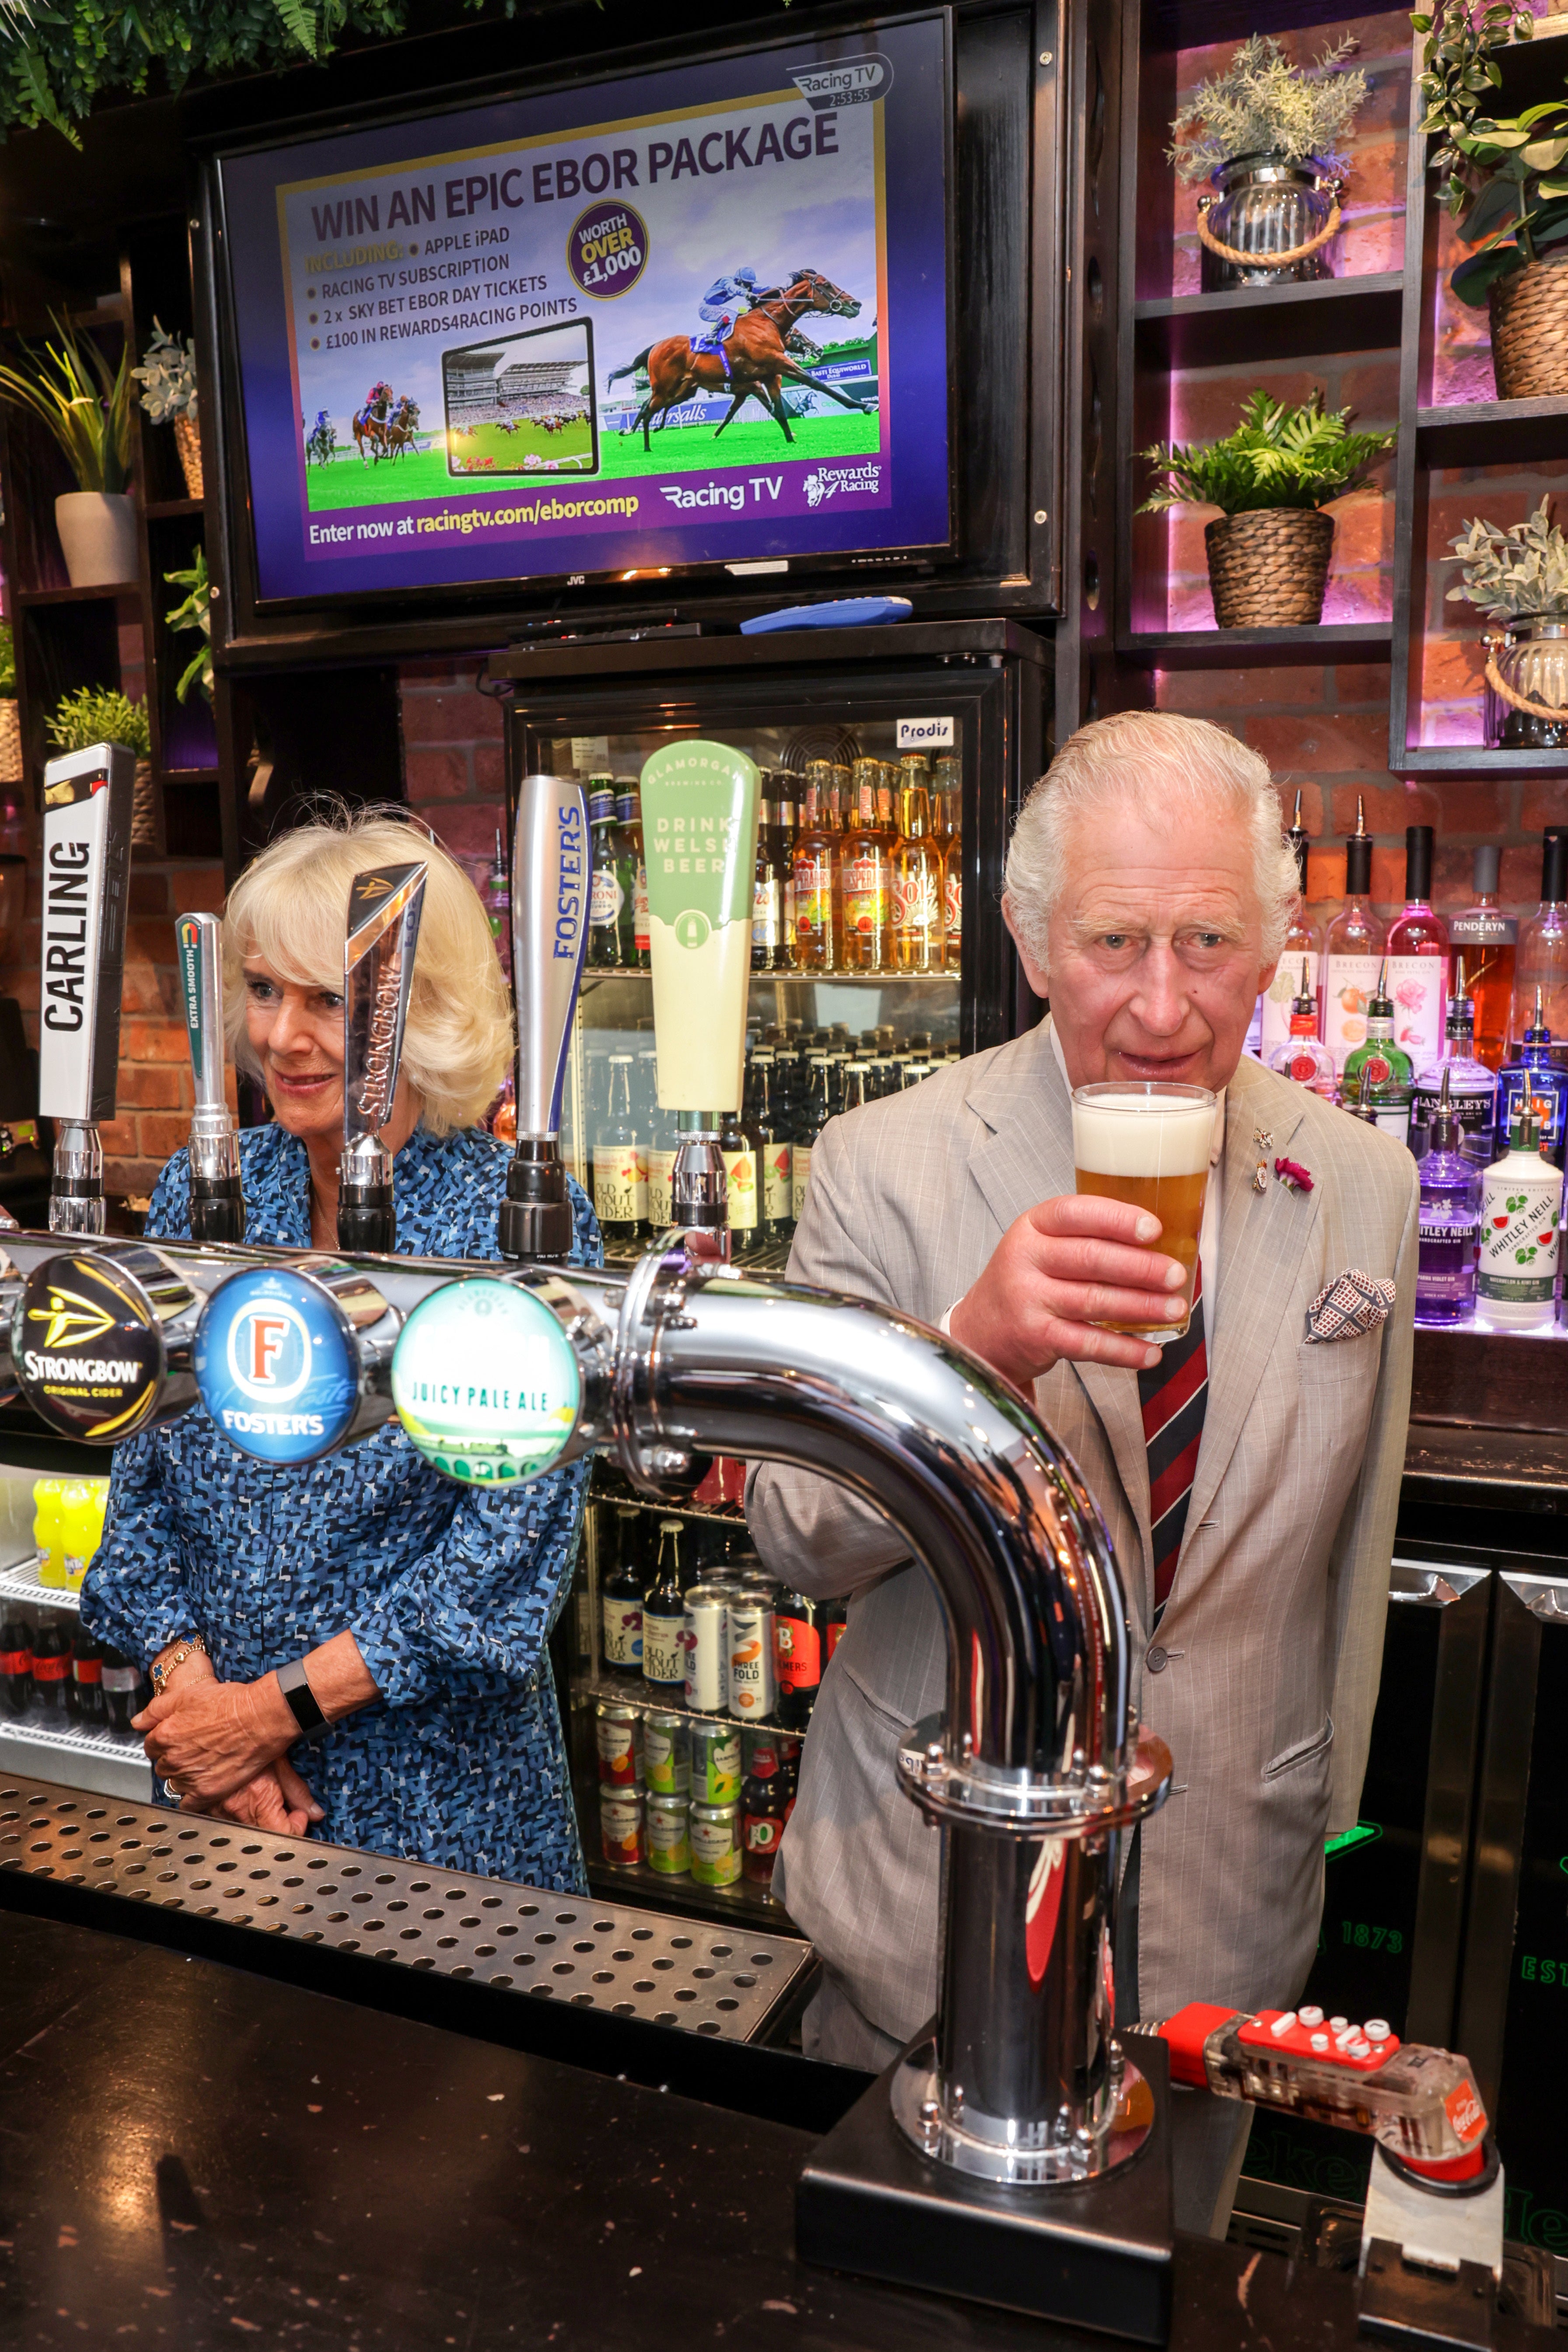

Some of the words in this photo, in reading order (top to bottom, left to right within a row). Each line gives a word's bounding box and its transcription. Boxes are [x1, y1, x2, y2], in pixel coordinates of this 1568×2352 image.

[797, 70, 852, 92] Racing
[854, 65, 875, 83] TV
[829, 89, 870, 107] 2:53:55
[311, 195, 380, 241] WIN
[387, 184, 436, 237] AN
[445, 168, 524, 219] EPIC
[533, 149, 639, 203] EBOR
[648, 112, 839, 184] PACKAGE
[578, 213, 628, 244] WORTH
[304, 239, 404, 276] INCLUDING:
[424, 229, 471, 256] APPLE
[475, 227, 510, 248] iPAD
[581, 227, 635, 264] OVER
[321, 271, 375, 299] RACING
[377, 273, 395, 291] TV
[398, 254, 510, 286] SUBSCRIPTION
[583, 246, 642, 287] £1,000
[324, 310, 332, 325] 2
[334, 312, 343, 323] x
[349, 300, 376, 321] SKY
[378, 297, 405, 316] BET
[409, 291, 449, 311] EBOR
[452, 285, 481, 304] DAY
[485, 276, 548, 299] TICKETS
[325, 330, 359, 350] £100
[361, 328, 377, 345] IN
[379, 307, 516, 341] REWARDS4RACING
[519, 297, 578, 321] POINTS
[828, 363, 867, 375] EQUIWORLD
[817, 462, 880, 482] Rewards
[658, 481, 745, 510] Racing
[748, 475, 783, 501] TV
[824, 481, 840, 499] 4
[840, 478, 879, 493] Racing
[309, 522, 354, 544] Enter
[356, 522, 395, 539] now
[396, 517, 415, 536] at
[416, 495, 639, 535] racingtv.com/eborcomp
[567, 575, 585, 586] JVC
[901, 718, 949, 741] Prodis
[657, 817, 733, 833] DRINK
[663, 858, 725, 873] BEER
[553, 806, 581, 960] FOSTER'S
[592, 890, 617, 900] RONI
[43, 841, 90, 1032] CARLING
[1453, 921, 1505, 932] PENDERYN
[185, 949, 196, 994] SMOOTH
[1336, 960, 1377, 969] BRECON
[1392, 960, 1435, 969] BRECON
[189, 995, 199, 1029] EXTRA
[357, 962, 402, 1116] STRONGBOW
[1515, 1098, 1552, 1109] HIG
[1420, 1225, 1448, 1237] ITLEY
[1450, 1225, 1474, 1237] NEILL
[1489, 1219, 1529, 1258] WHITLEY
[1528, 1195, 1554, 1223] NEILL
[249, 1315, 290, 1385] F
[23, 1350, 139, 1384] STRONGBOW
[43, 1384, 89, 1397] ORIGINAL
[91, 1387, 123, 1398] CIDER
[412, 1381, 461, 1405] JUICY
[468, 1386, 510, 1410] PALE
[518, 1391, 548, 1412] ALE
[221, 1409, 325, 1436] FOSTER'S
[733, 1668, 759, 1680] FOLD
[1341, 1921, 1404, 1954] 1873
